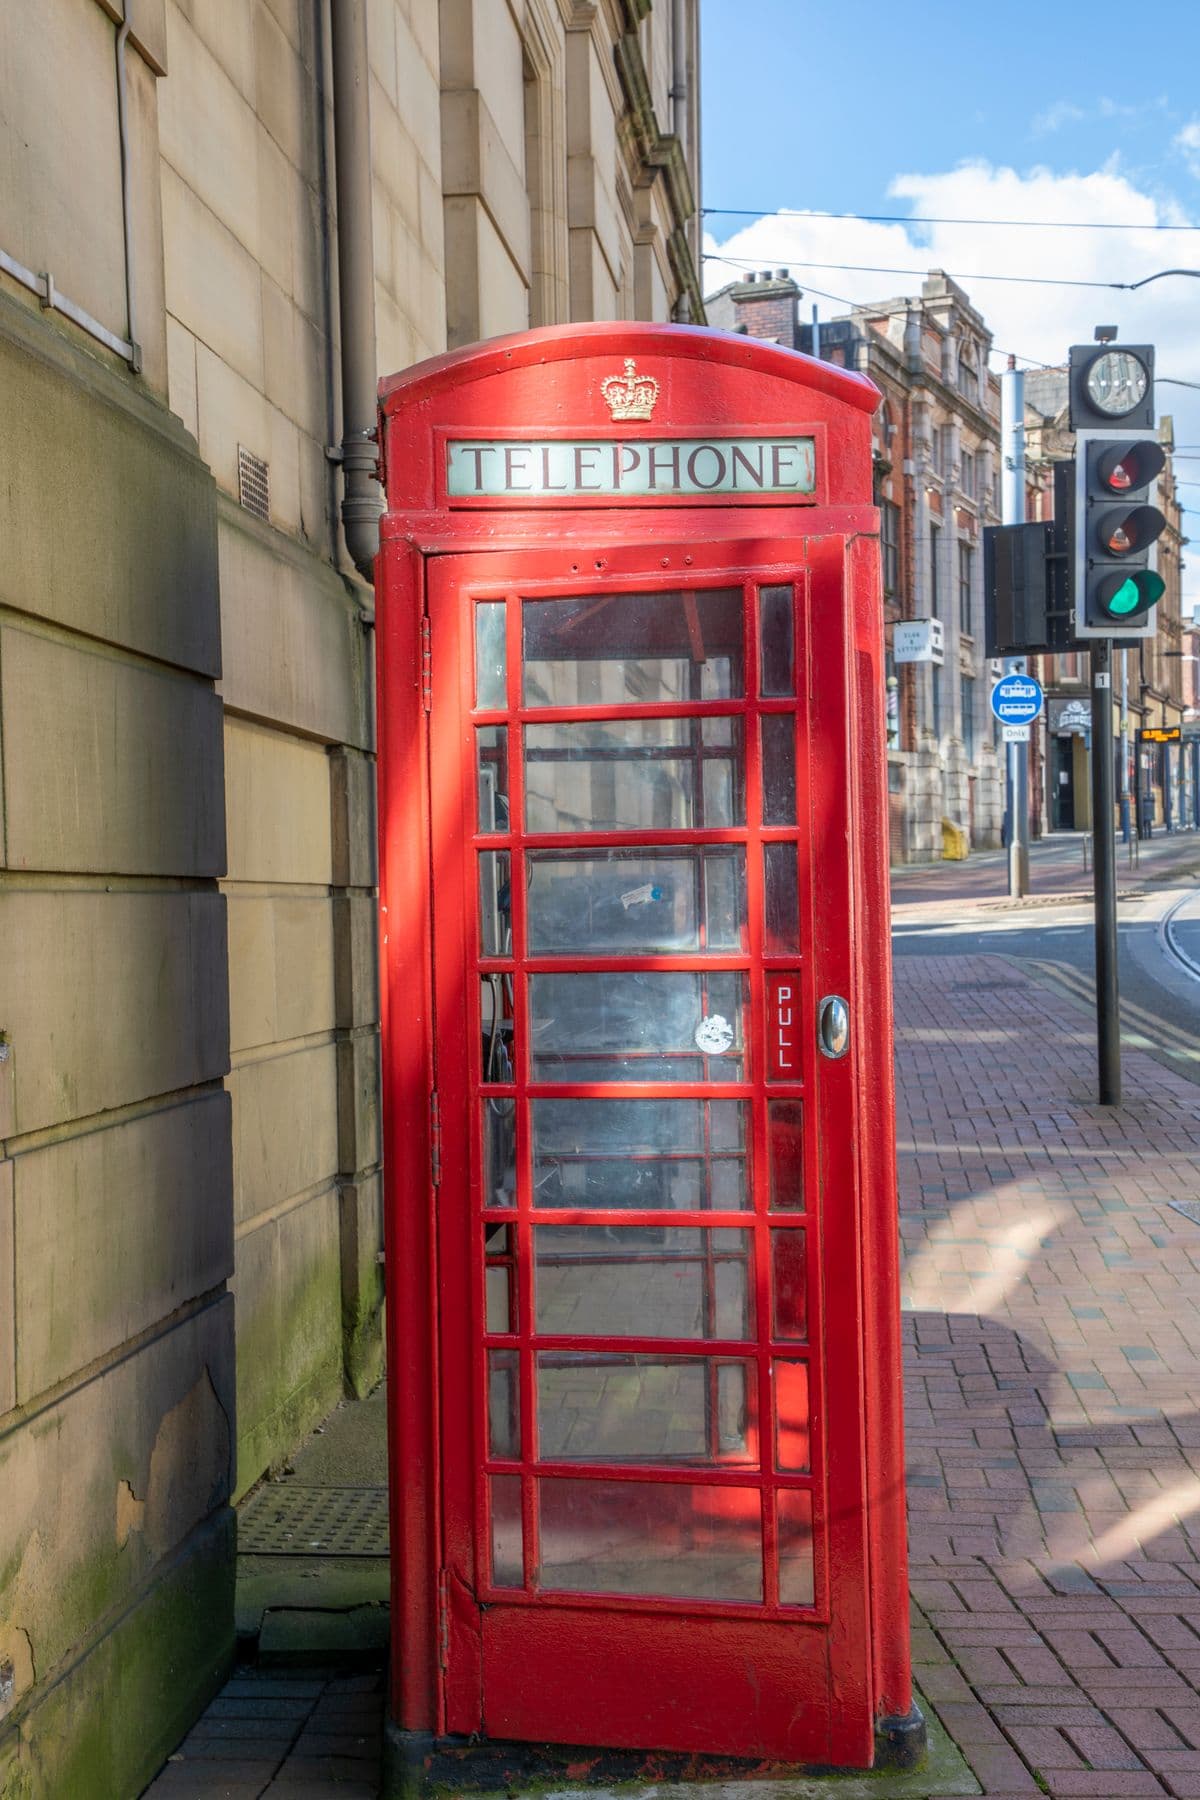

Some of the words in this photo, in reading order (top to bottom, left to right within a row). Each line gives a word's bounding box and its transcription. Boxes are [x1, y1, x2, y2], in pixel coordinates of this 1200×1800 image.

[461, 445, 799, 490] TELEPHONE
[1006, 728, 1026, 739] Only
[778, 986, 793, 1067] PULL
